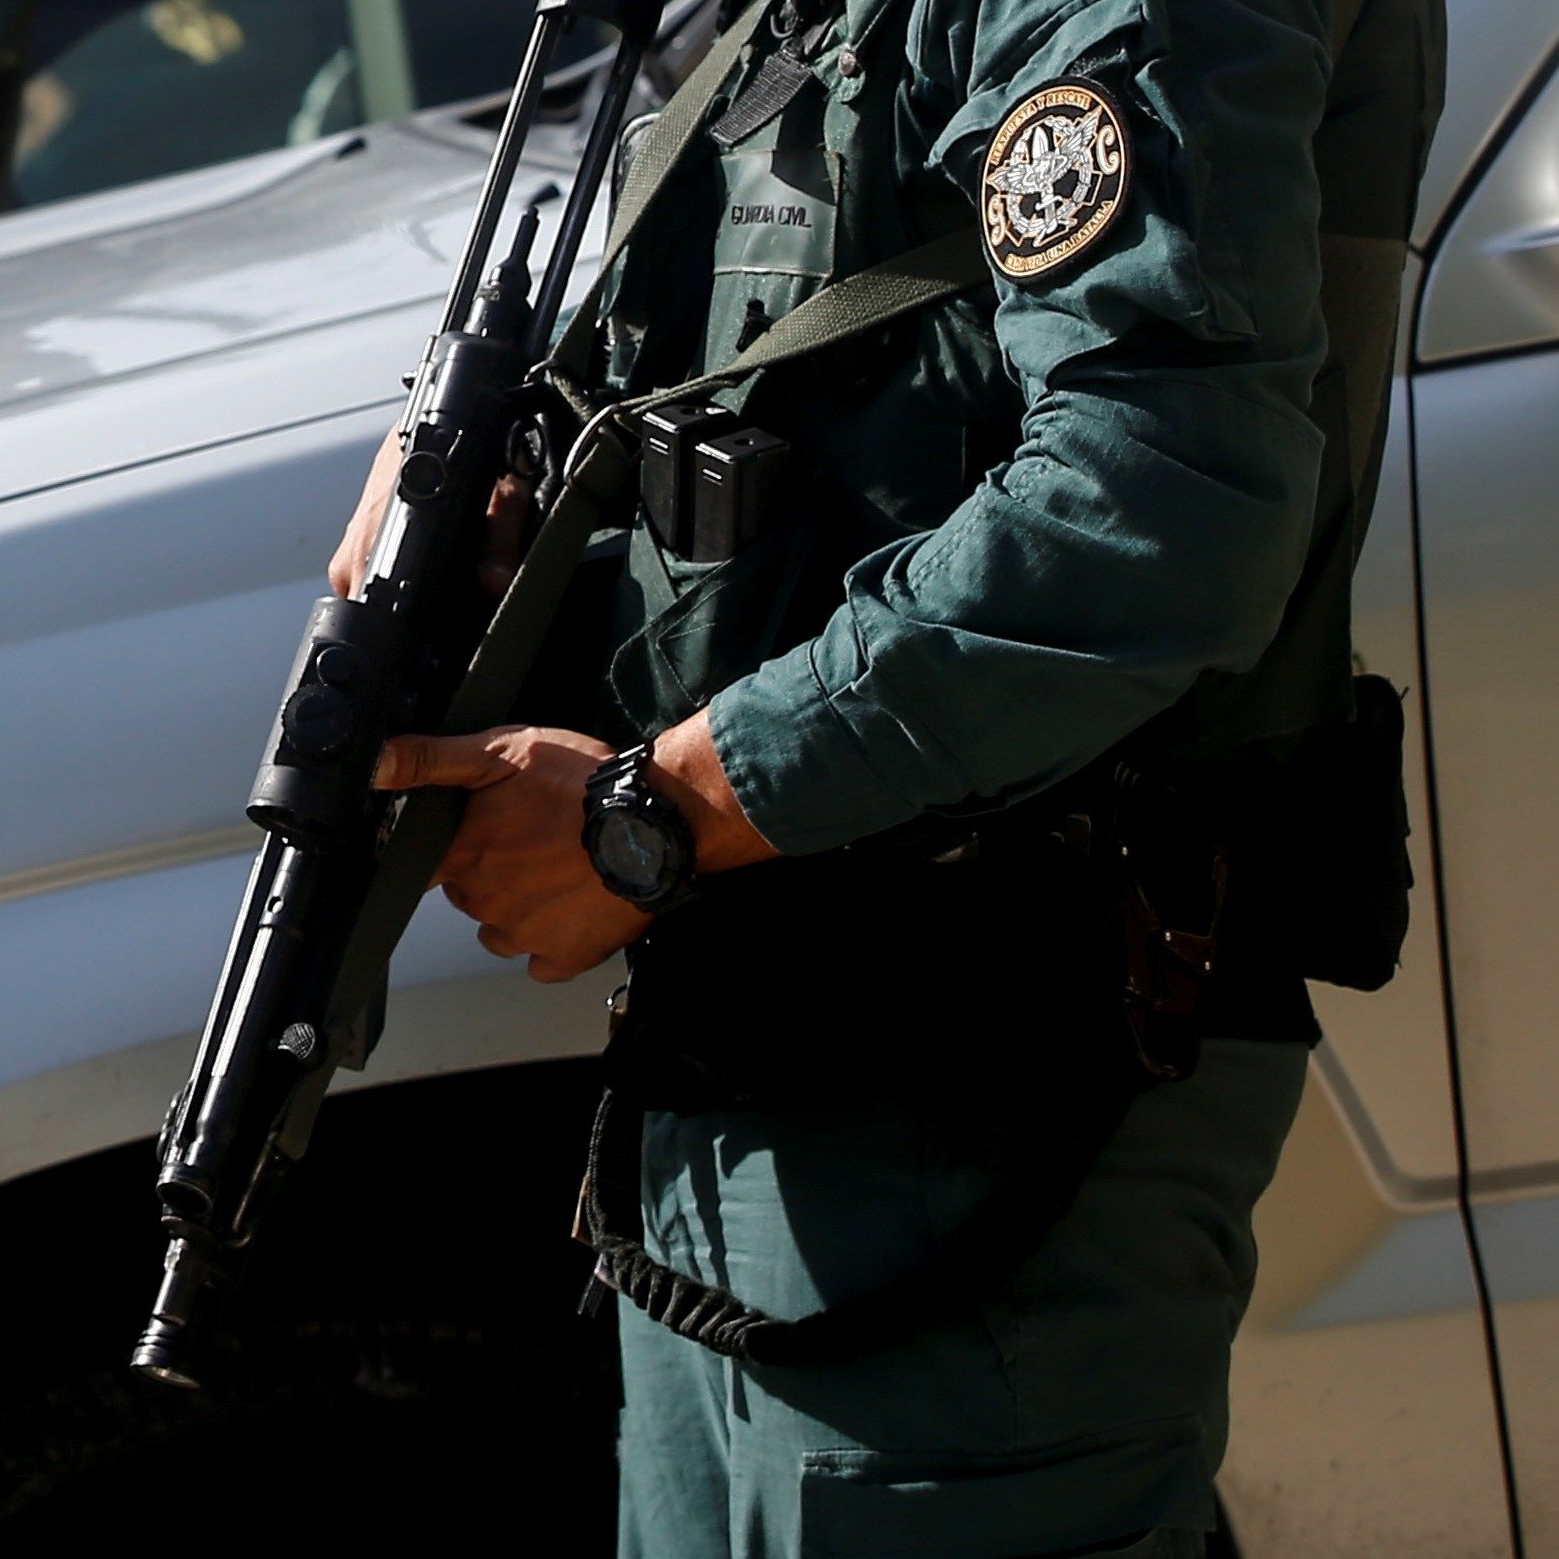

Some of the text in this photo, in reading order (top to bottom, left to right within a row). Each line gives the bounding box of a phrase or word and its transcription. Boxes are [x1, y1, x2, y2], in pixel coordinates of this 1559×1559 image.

[1045, 92, 1092, 111] RESCATE
[731, 205, 812, 228] GUARDIA CIVIL
